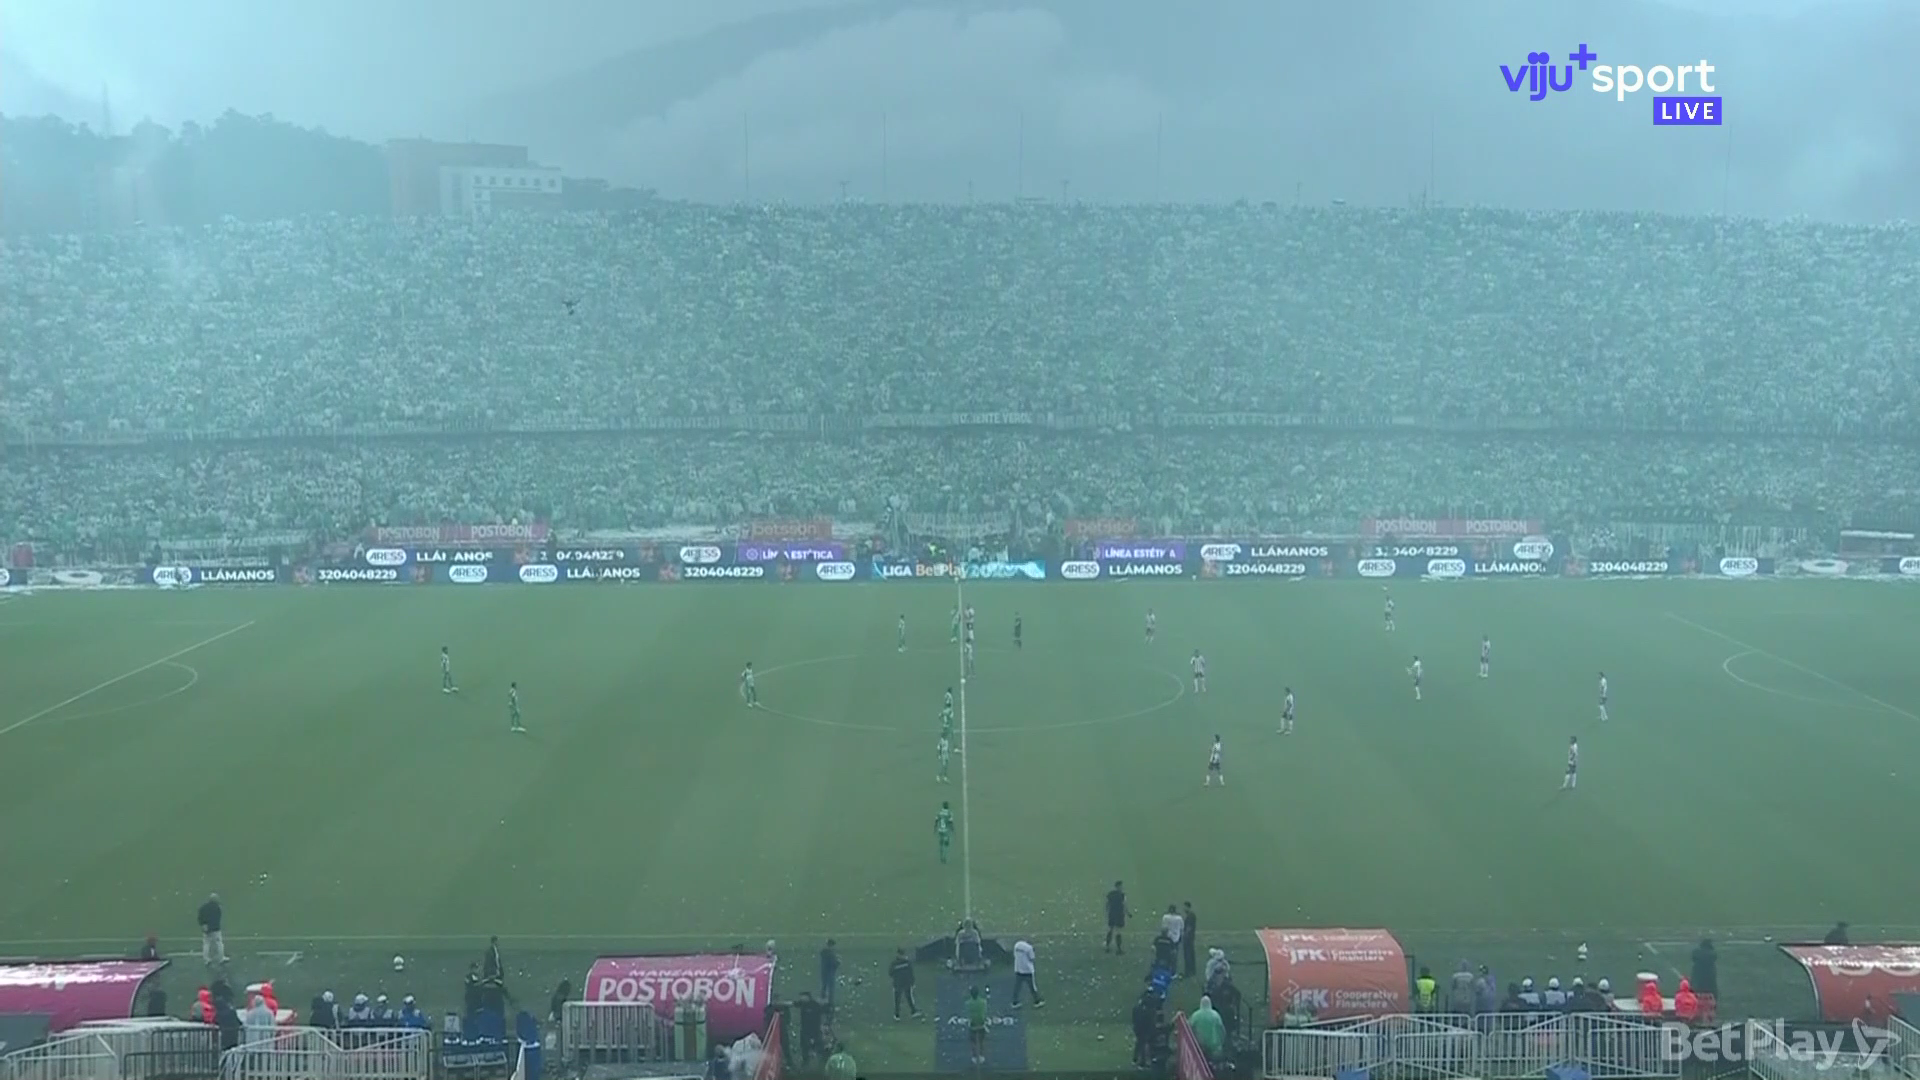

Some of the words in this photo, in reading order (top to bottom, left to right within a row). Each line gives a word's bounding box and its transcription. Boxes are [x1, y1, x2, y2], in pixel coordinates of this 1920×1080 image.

[370, 552, 404, 561] ARESS
[1105, 547, 1132, 558] LÍNEA
[1251, 545, 1328, 557] LLÁMANOS
[1064, 564, 1097, 573] ARESS
[1109, 563, 1183, 575] LLÁMANOS
[1226, 564, 1306, 575] 3204048229
[1361, 563, 1394, 572] ARESS
[1431, 563, 1464, 572] ARESS
[1590, 561, 1668, 572] 3204048229
[1723, 560, 1757, 569] ARESS
[200, 568, 275, 580] LLÁMANOS
[318, 569, 397, 580] 3204048229
[452, 568, 485, 577] ARESS
[522, 568, 555, 577] ARESS
[684, 567, 764, 578] 3204048229
[820, 566, 853, 575] ARESS
[883, 565, 912, 577] LIGA
[1289, 948, 1328, 965] JFK
[1335, 989, 1399, 1002] Cooperativa
[1335, 999, 1388, 1009] Financiera
